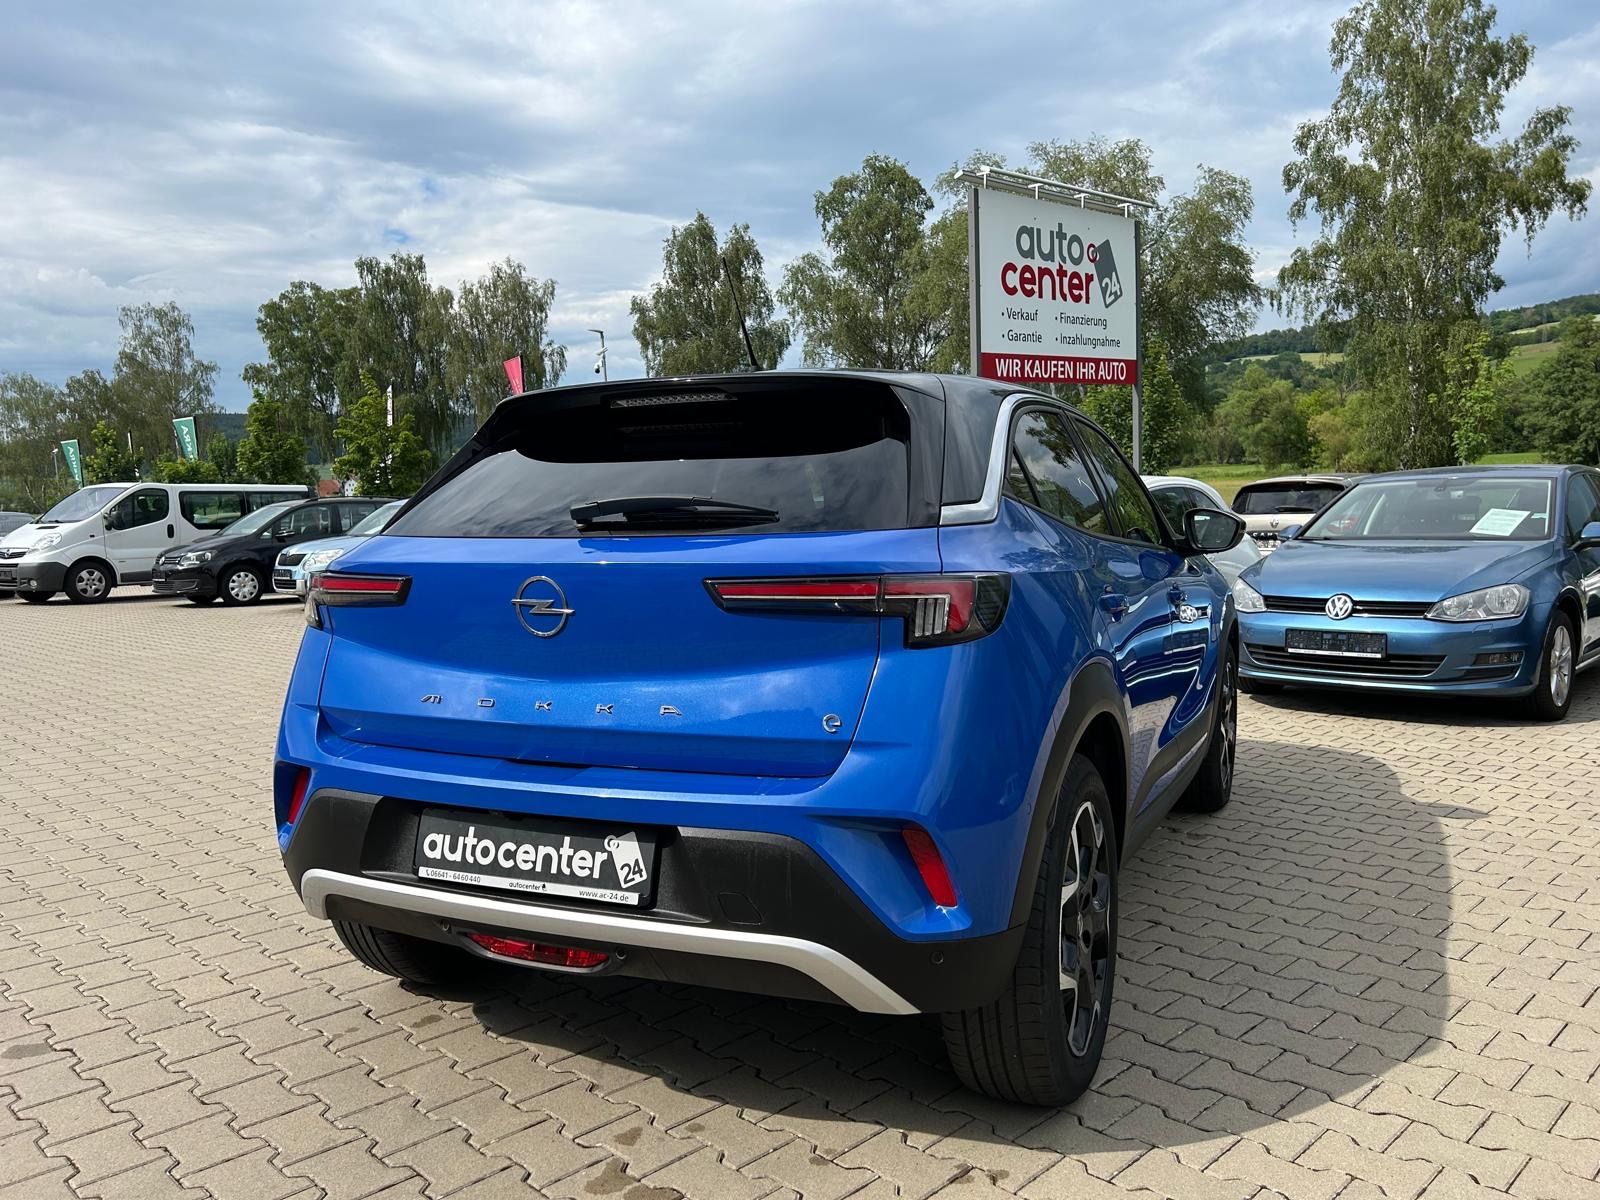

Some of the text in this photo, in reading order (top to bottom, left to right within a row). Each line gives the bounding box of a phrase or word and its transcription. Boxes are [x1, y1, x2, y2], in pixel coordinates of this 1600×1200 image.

[1015, 222, 1084, 266] auto
[1001, 261, 1094, 304] center
[1102, 271, 1121, 305] 24
[1006, 308, 1038, 322] Verkauf
[1059, 312, 1107, 330] Finanzierung
[1007, 329, 1042, 343] Garantie
[1060, 333, 1121, 349] Inzahlungnahme
[995, 358, 1126, 381] WIR KAUFEN IHR AUTO
[420, 693, 682, 717] MOKKA
[423, 826, 608, 879] autocenter
[620, 858, 644, 884] 24
[509, 882, 541, 891] autocenter
[579, 889, 630, 902] www.ac-24.de
